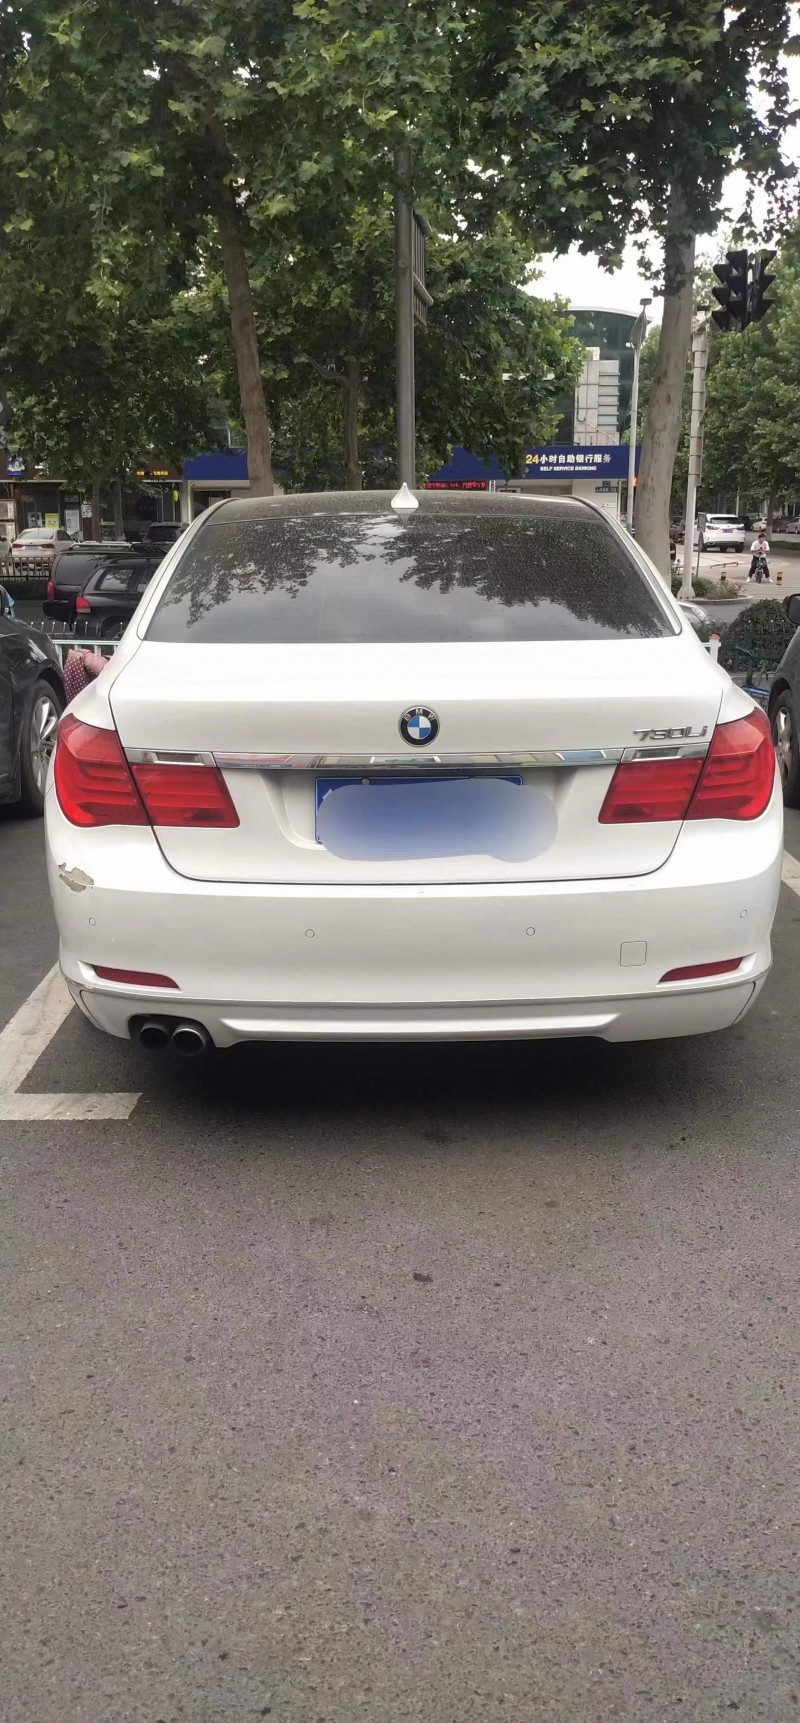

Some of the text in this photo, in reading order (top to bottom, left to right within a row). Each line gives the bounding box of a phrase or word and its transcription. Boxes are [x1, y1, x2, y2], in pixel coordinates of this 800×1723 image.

[525, 454, 611, 464] 24小时自助银行服务
[403, 708, 436, 721] BMW
